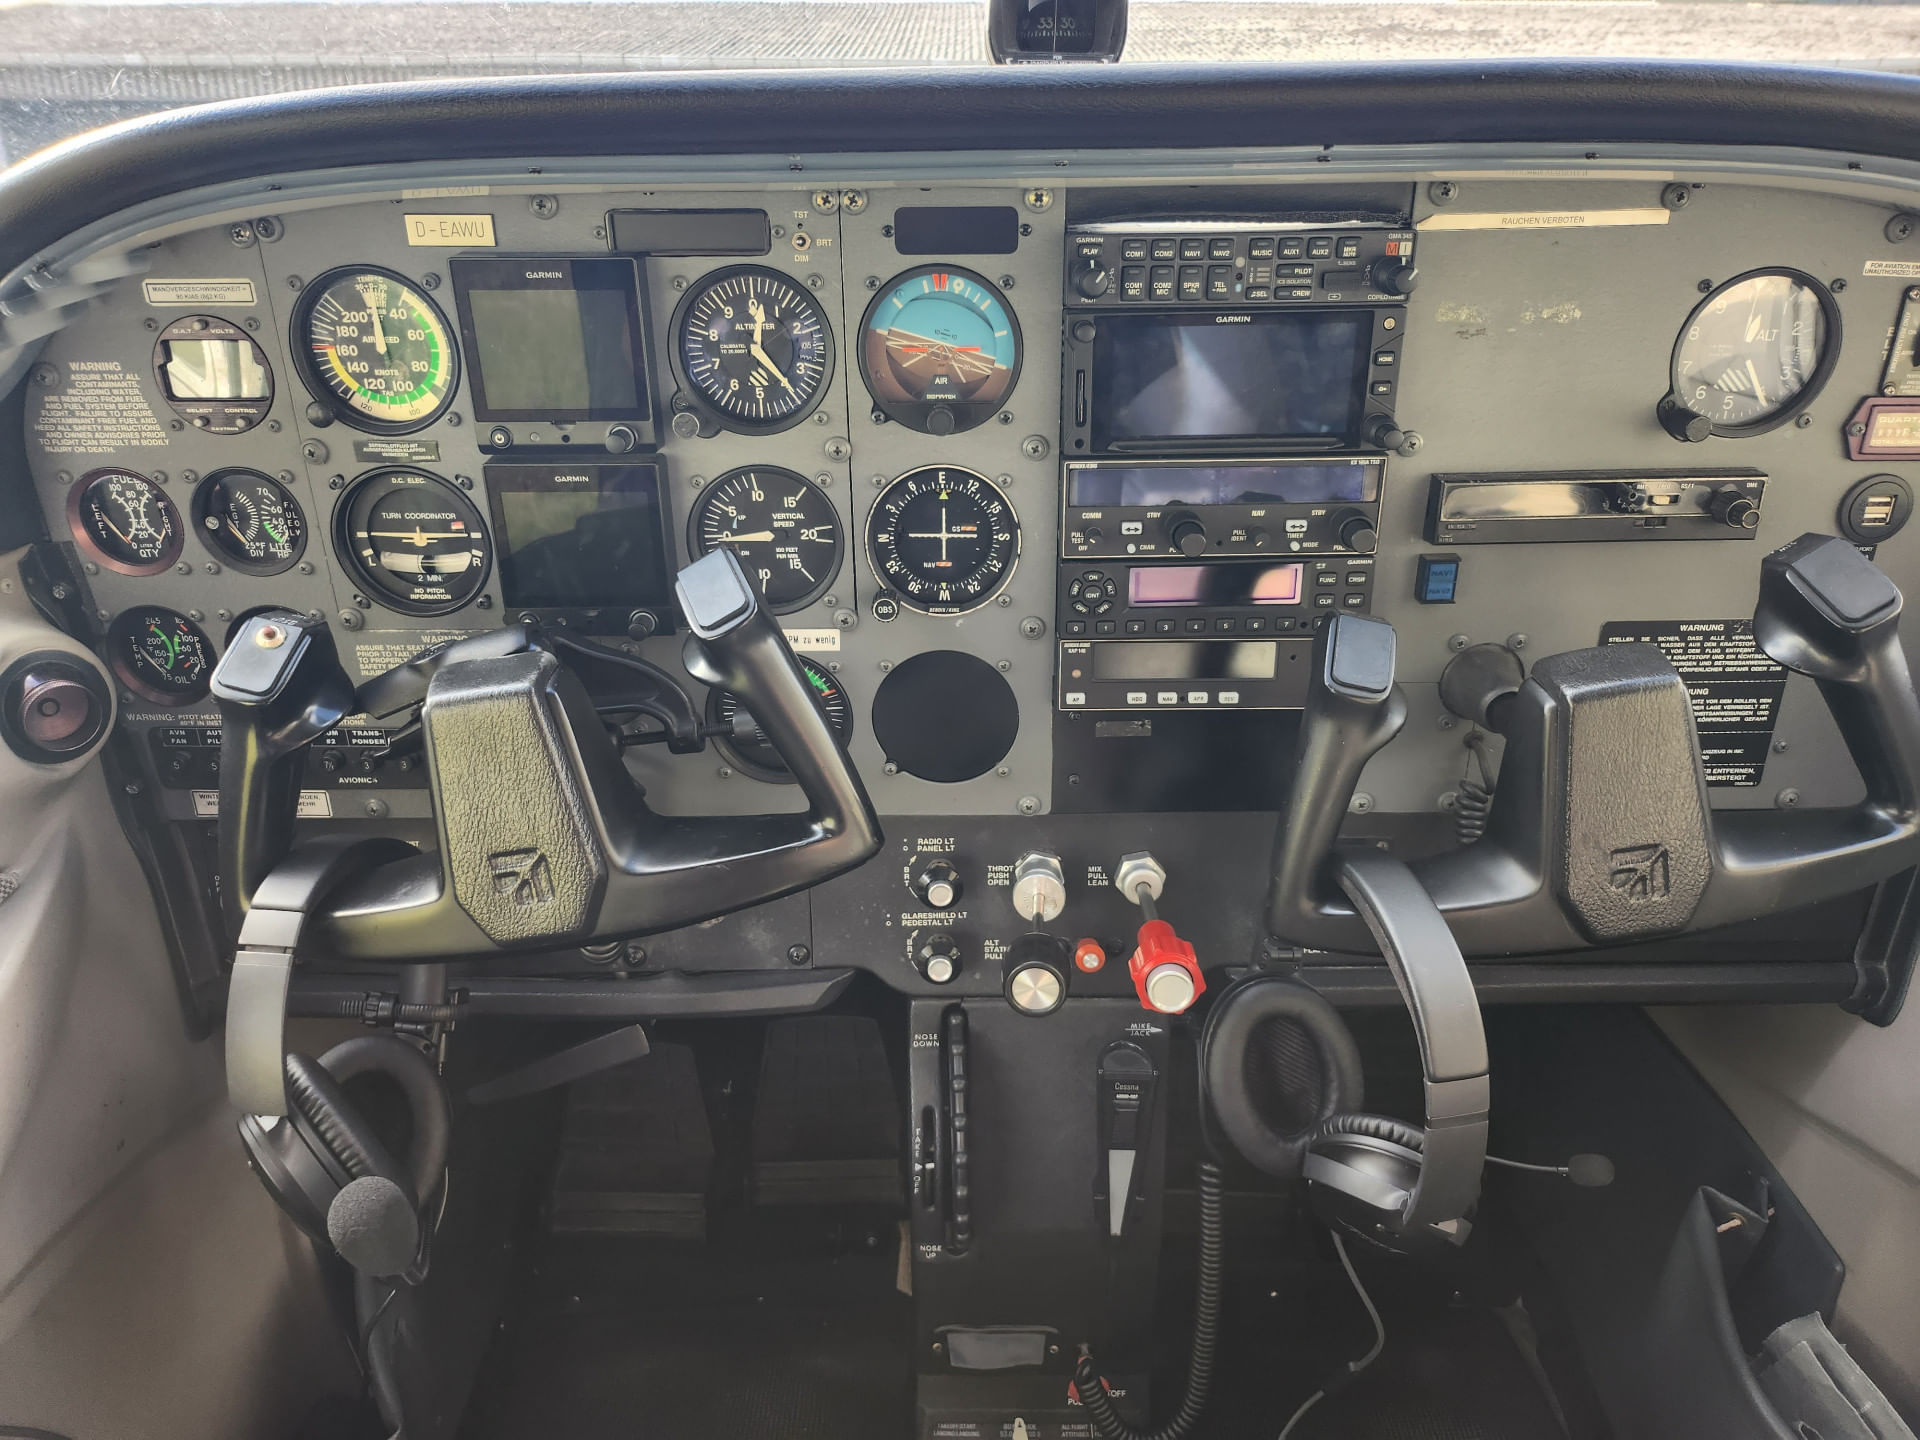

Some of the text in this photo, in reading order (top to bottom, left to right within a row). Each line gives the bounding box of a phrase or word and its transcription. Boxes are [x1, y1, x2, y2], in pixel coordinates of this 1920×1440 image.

[793, 211, 808, 219] TST
[1501, 215, 1585, 226] RAUCHEN VERBOTEN
[415, 221, 486, 239] D-EAWU
[816, 239, 832, 247] BRT
[794, 255, 809, 263] DIM
[526, 271, 562, 279] GARMIN
[341, 311, 368, 323] 200
[389, 309, 407, 320] 40
[724, 307, 734, 319] 9
[1215, 315, 1251, 324] GARMIN
[336, 326, 358, 337] 180
[793, 323, 801, 334] 2
[1689, 326, 1700, 340] 8
[408, 330, 425, 341] 60
[709, 330, 719, 341] 8
[1757, 329, 1779, 342] ALT
[336, 345, 358, 356] 160
[69, 362, 121, 371] WARNING
[347, 362, 369, 373] 140
[411, 361, 428, 372] 80
[712, 359, 720, 369] 7
[796, 363, 805, 373] 3
[364, 379, 385, 390] 120
[392, 381, 414, 392] 100
[730, 379, 739, 390] 6
[935, 377, 948, 385] AIR
[755, 387, 764, 398] 5
[1696, 385, 1707, 399] 6
[1723, 396, 1734, 410] 5
[938, 472, 946, 484] E
[908, 481, 917, 492] 6
[967, 479, 980, 492] 12
[752, 490, 764, 502] 10
[129, 500, 139, 508] 60
[784, 497, 796, 508] 15
[990, 501, 1002, 514] 15
[728, 506, 736, 517] 5
[885, 504, 896, 513] 3
[404, 512, 456, 520] COORDINATOR
[800, 529, 817, 540] 20
[877, 534, 890, 543] N
[998, 533, 1010, 541] S
[140, 549, 159, 557] QTY
[369, 557, 377, 567] L
[472, 557, 481, 567] R
[790, 559, 802, 569] 15
[886, 560, 899, 574] 33
[989, 560, 1002, 573] 21
[759, 569, 771, 579] 10
[908, 581, 922, 594] 30
[967, 581, 981, 594] 24
[939, 590, 950, 601] W
[878, 606, 893, 614] OBS
[1680, 624, 1725, 632] WARNUNG
[147, 637, 161, 645] 200
[816, 636, 836, 645] wenig
[175, 676, 191, 684] OIL
[126, 713, 175, 721] WARNING:
[1115, 1082, 1139, 1091] Cessna
